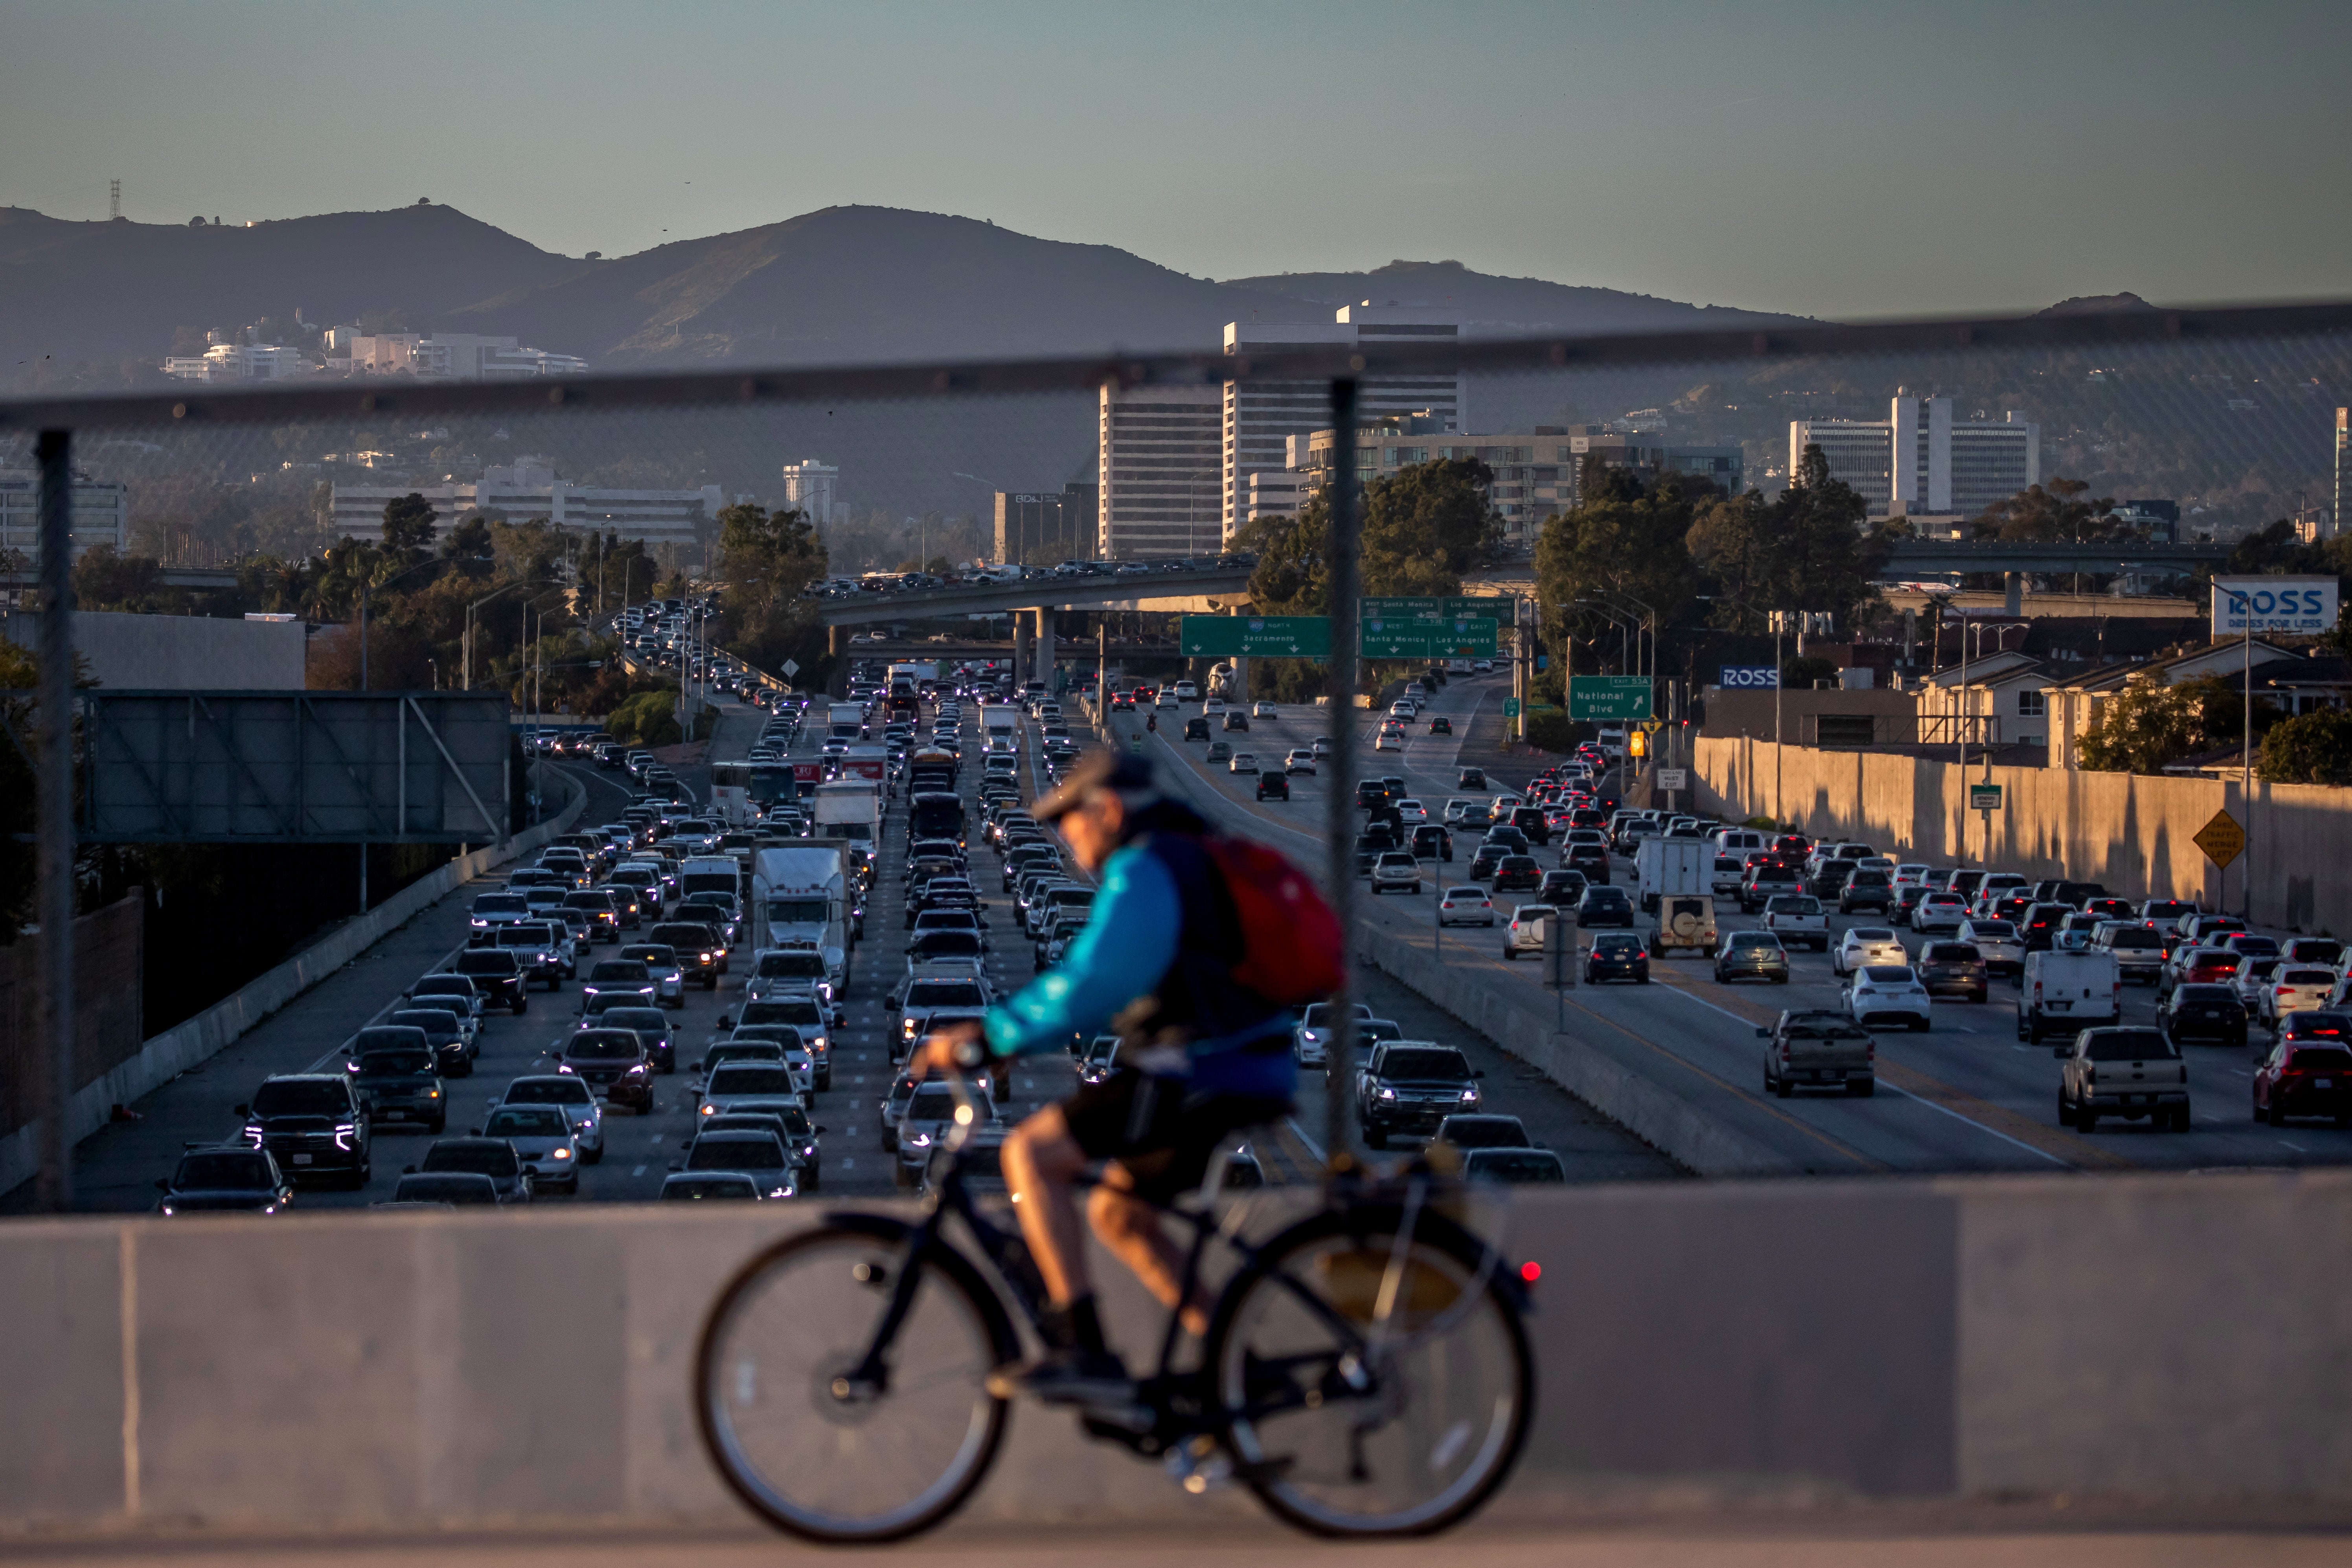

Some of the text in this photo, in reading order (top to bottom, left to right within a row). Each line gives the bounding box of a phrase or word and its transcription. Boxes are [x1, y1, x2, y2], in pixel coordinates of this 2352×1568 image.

[1015, 494, 1043, 503] BD&J
[2229, 590, 2323, 614] ROSS
[2267, 619, 2289, 628] FOR
[2295, 619, 2322, 628] LESS
[1456, 636, 1490, 645] Angeles
[1723, 669, 1779, 686] ROSS
[1577, 691, 1624, 700] National
[1589, 704, 1613, 713] Blvd
